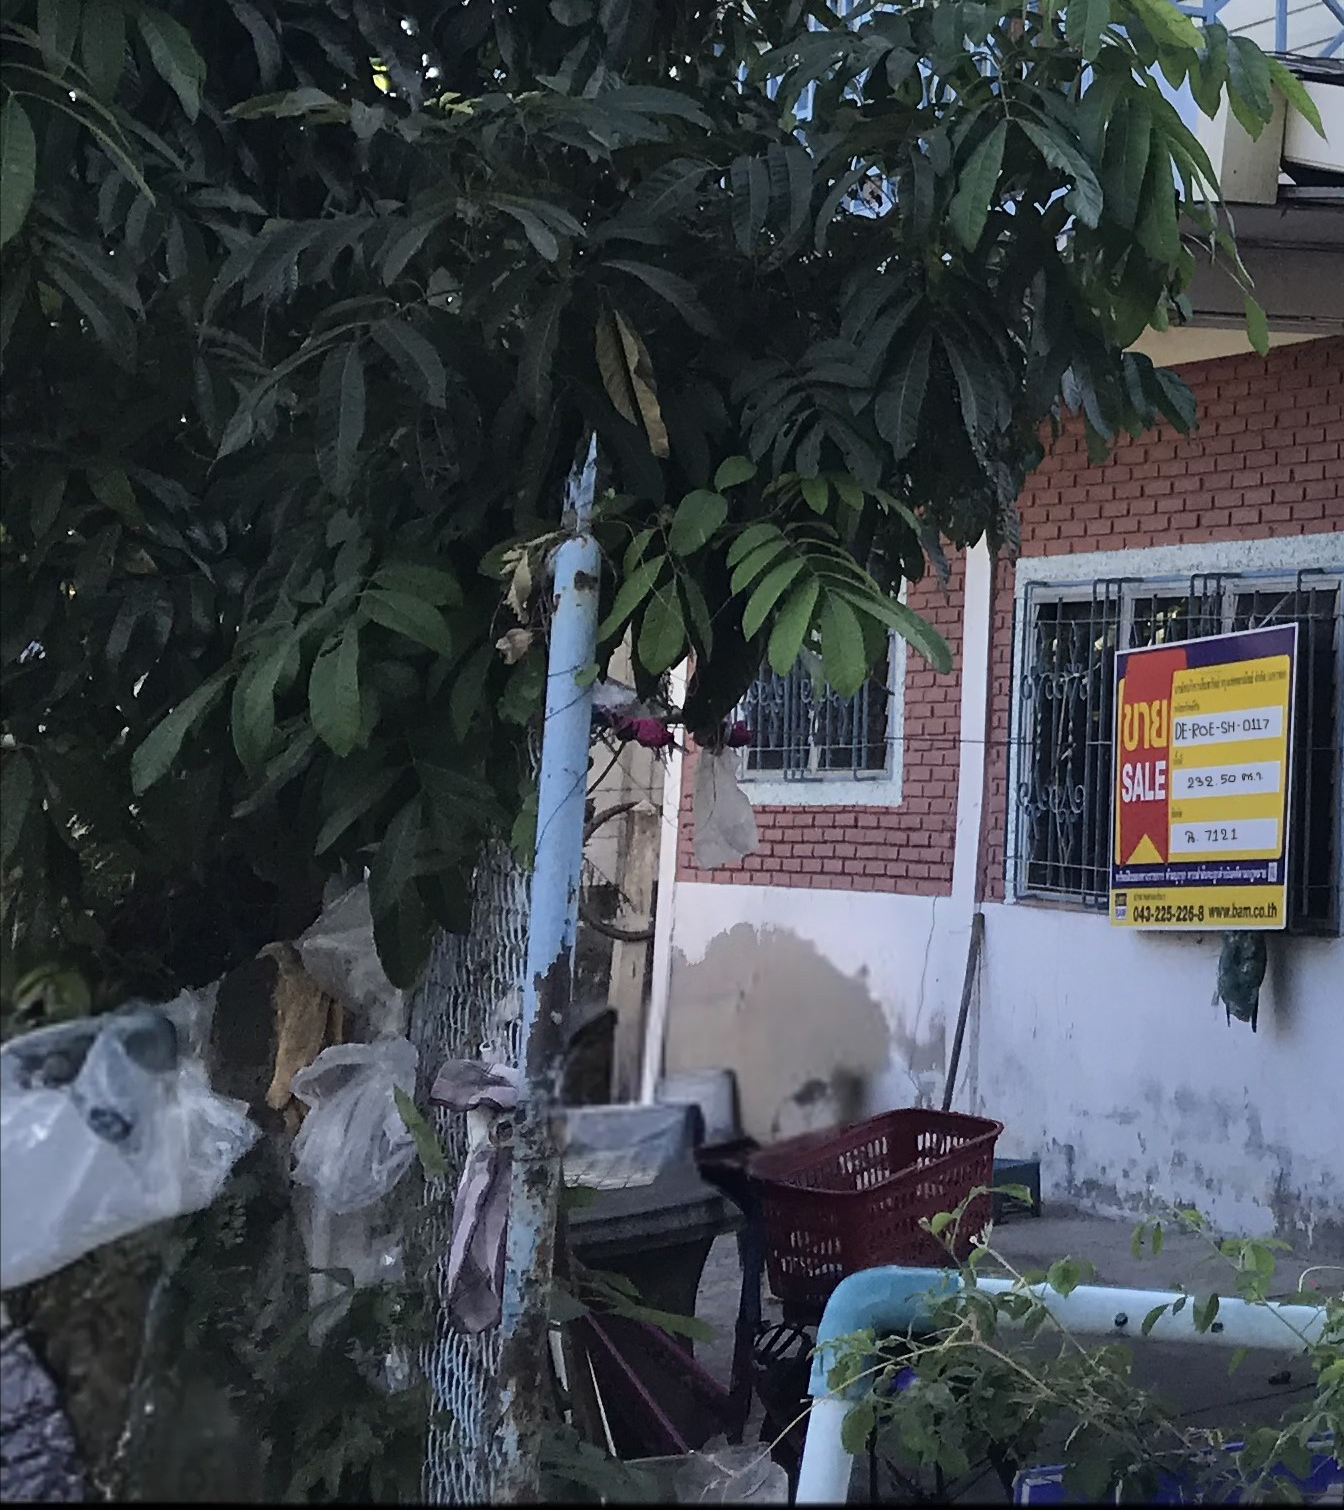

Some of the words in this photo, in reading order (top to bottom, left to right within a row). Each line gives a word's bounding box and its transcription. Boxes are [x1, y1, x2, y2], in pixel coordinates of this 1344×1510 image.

[1123, 699, 1168, 752] ขาย
[1174, 718, 1270, 741] DE-ROE-SH-0117
[1121, 760, 1167, 803] SALE
[1204, 828, 1238, 842] 7121
[1133, 905, 1204, 923] 043-225-226-8
[1208, 901, 1278, 919] www.bam.co.th
